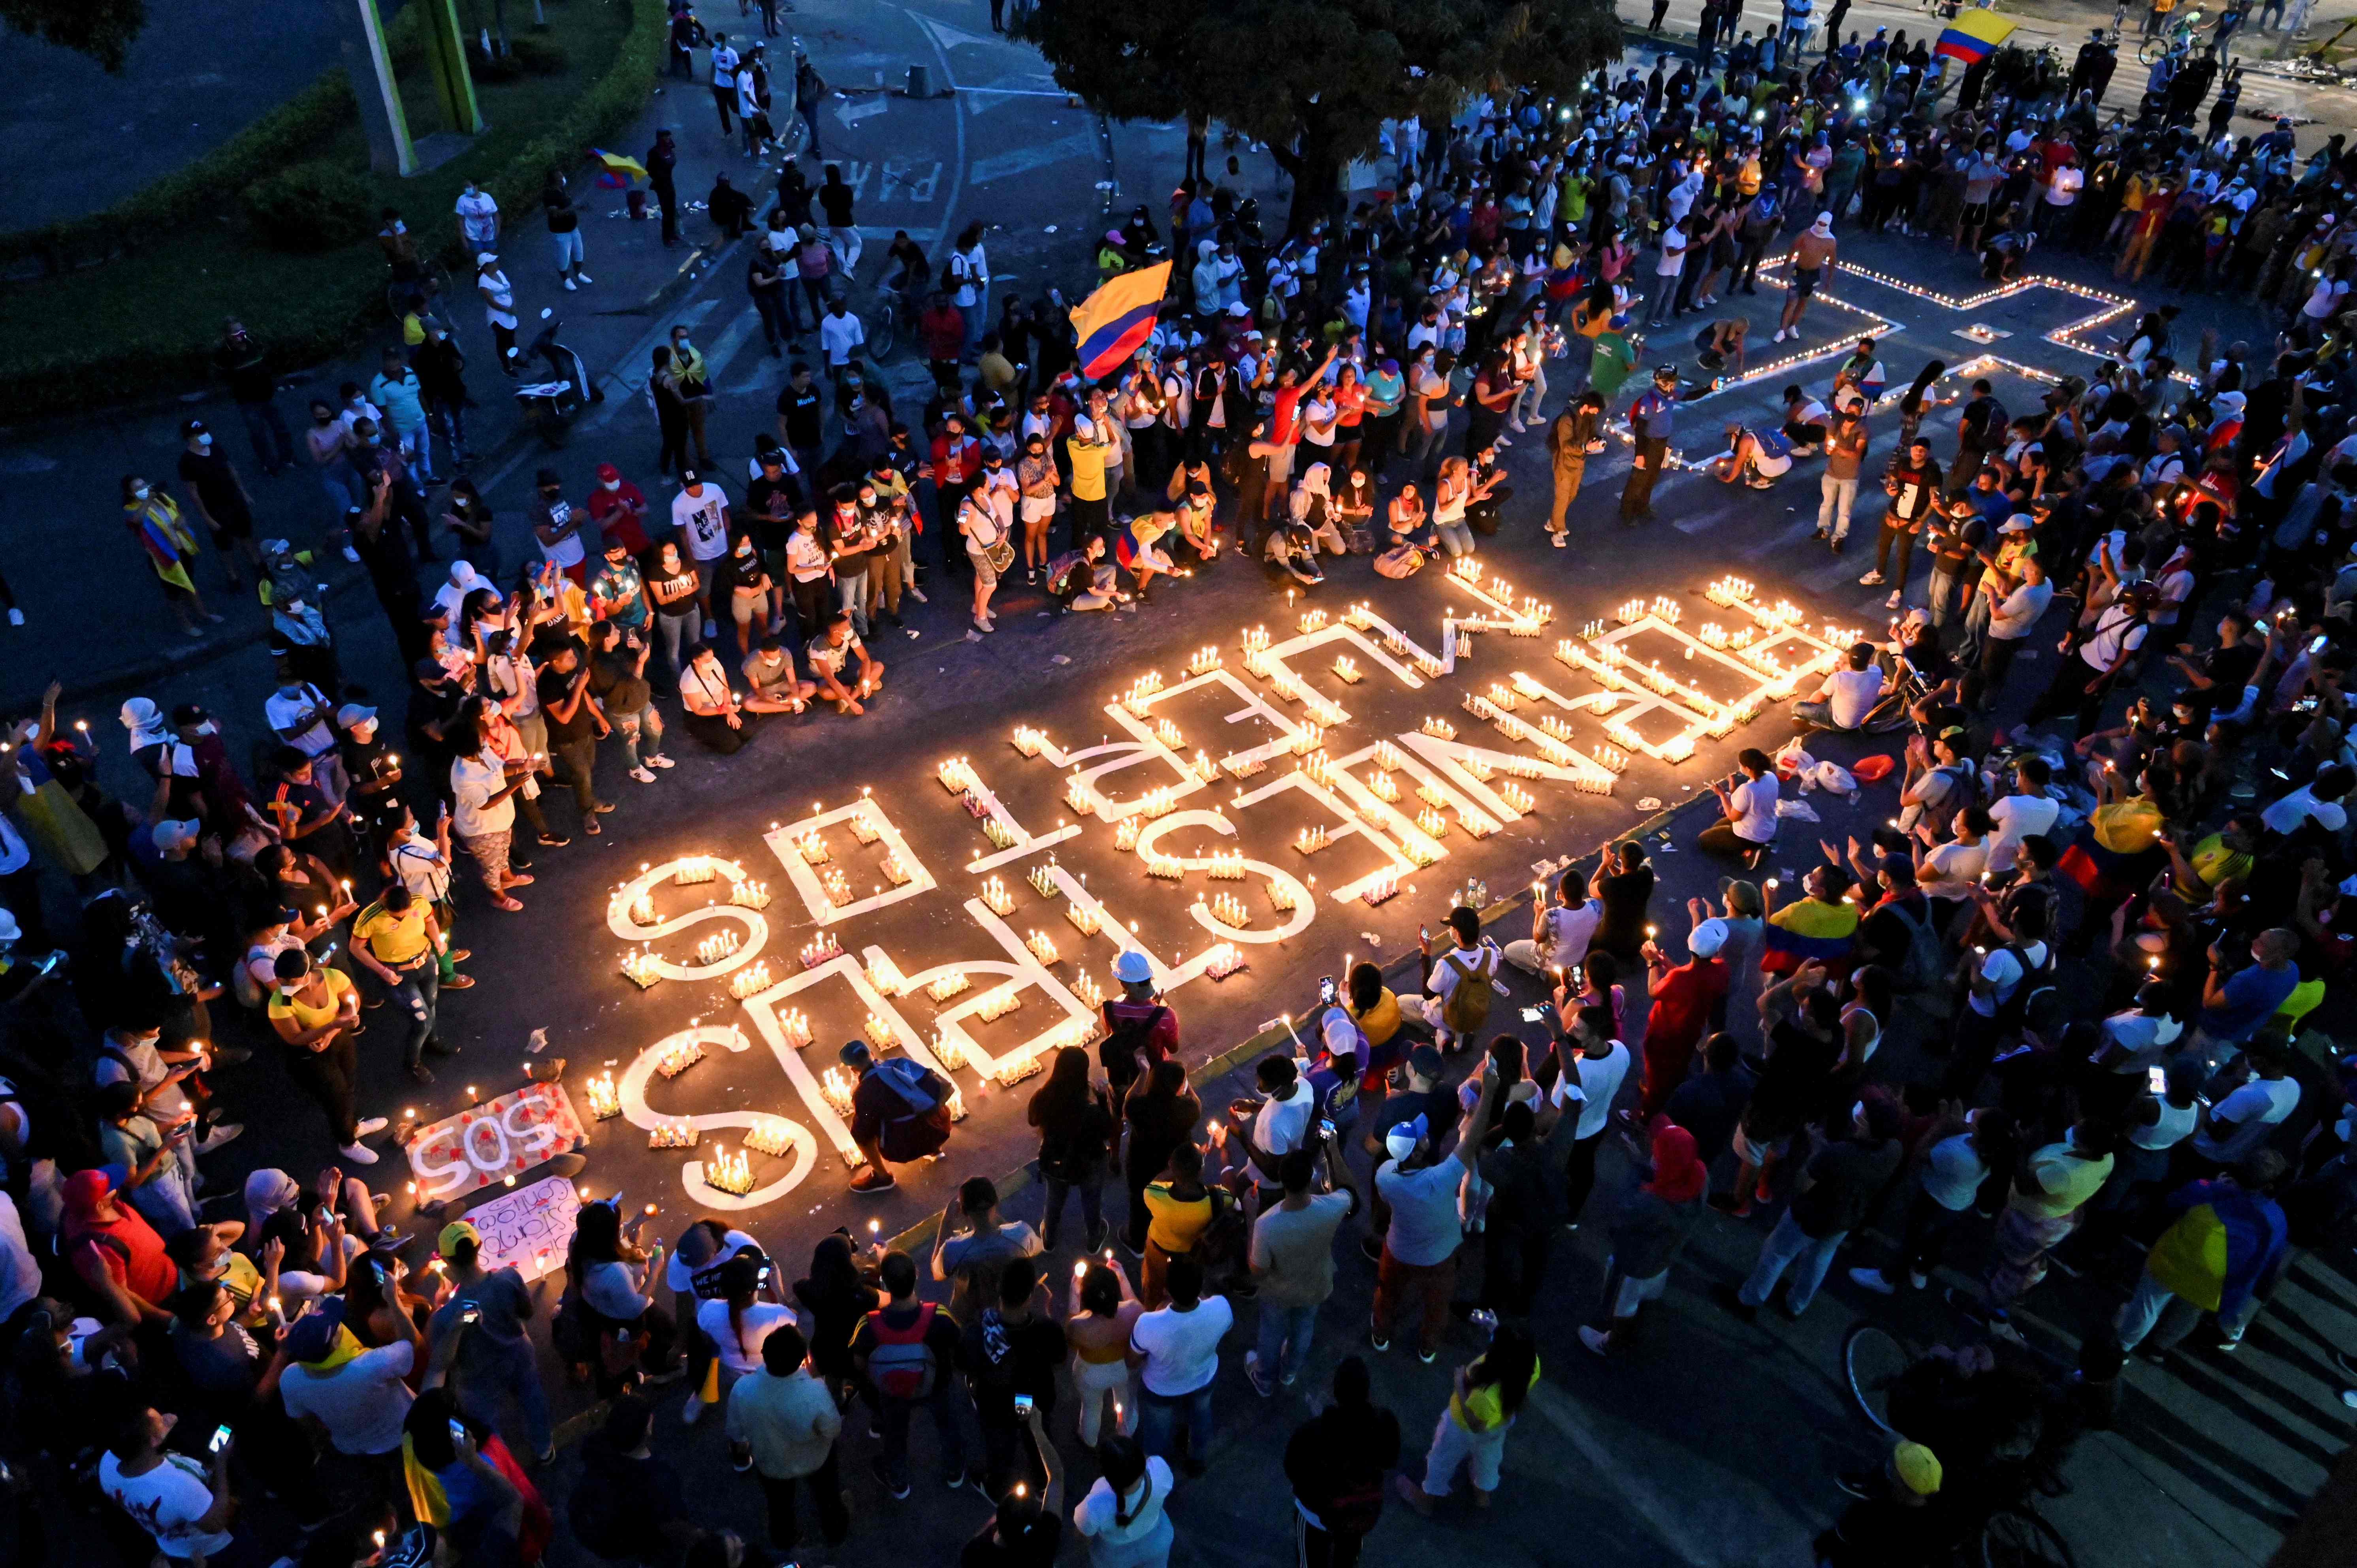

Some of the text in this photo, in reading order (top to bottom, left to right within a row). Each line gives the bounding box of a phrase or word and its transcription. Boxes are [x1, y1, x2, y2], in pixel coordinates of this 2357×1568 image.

[796, 395, 816, 407] Music
[607, 574, 1541, 981] MUERTOS
[620, 585, 1847, 1210] POR NUESTROS
[412, 1095, 555, 1195] SOS
